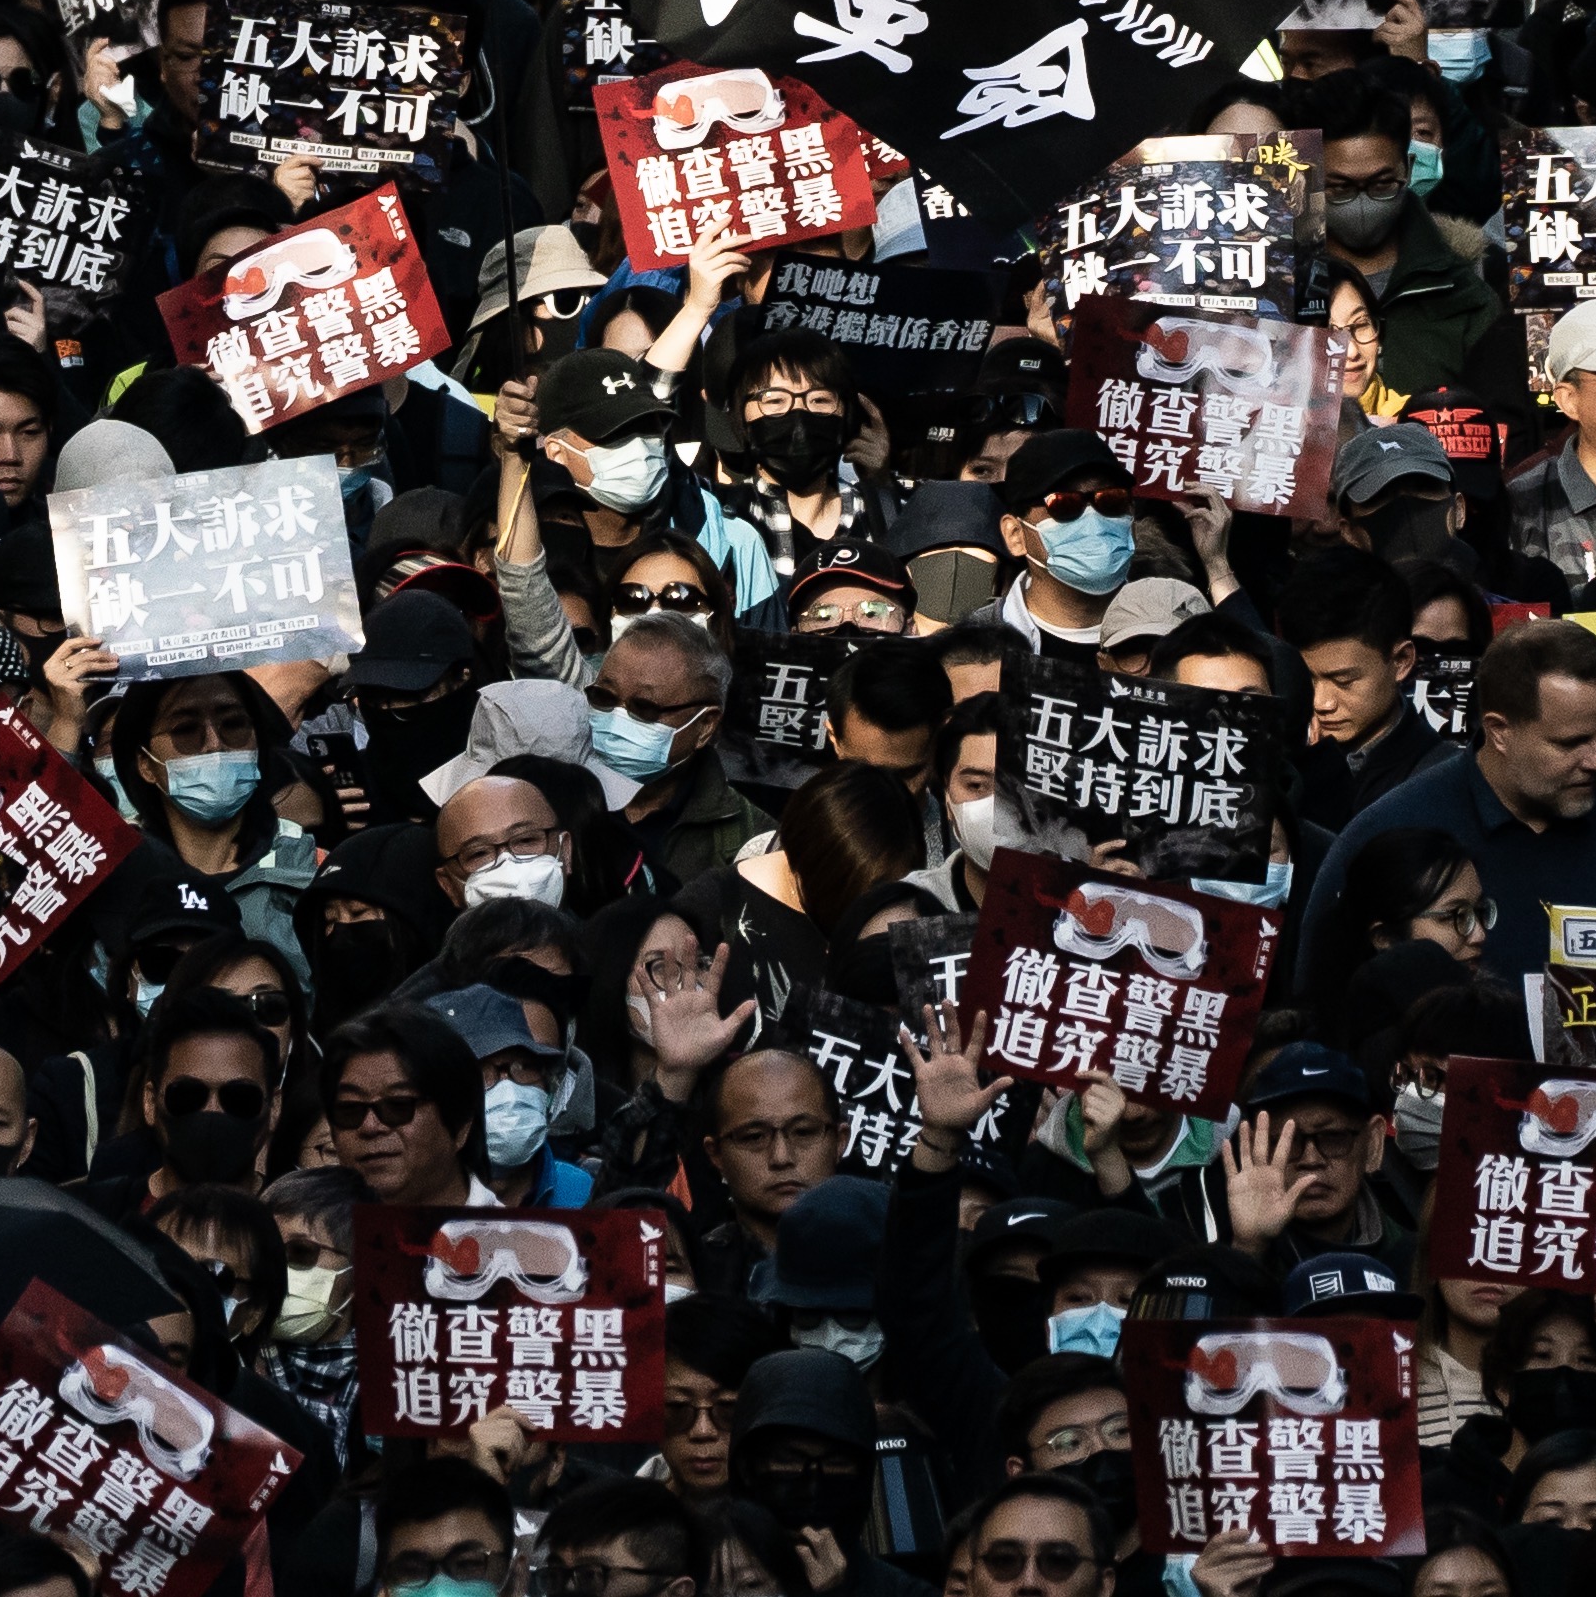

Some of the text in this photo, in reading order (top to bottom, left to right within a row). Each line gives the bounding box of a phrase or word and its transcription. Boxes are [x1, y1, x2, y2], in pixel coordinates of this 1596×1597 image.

[223, 16, 441, 84] 五大訴求
[218, 71, 435, 142] 缺一不可
[636, 124, 833, 209] 徹查警黑
[1058, 184, 1270, 254] 五大訴求
[778, 262, 878, 304] 我哋想
[1063, 239, 1270, 309] 缺一不可
[206, 266, 408, 369] 徹查警黑
[228, 314, 423, 429] 追究警暴
[1096, 379, 1303, 454] 徹查警黑
[78, 494, 323, 574] 五大訴求
[88, 544, 325, 634] 缺一不可
[1028, 694, 1248, 779] 五大訴求
[1025, 744, 1241, 829] 堅持到底
[179, 883, 208, 910] LA
[1003, 946, 1228, 1049] 徹查警黑
[986, 1009, 1213, 1101] 追究警暴
[388, 1304, 628, 1369] 徹查警黑
[1160, 1416, 1385, 1484] 徹查警黑
